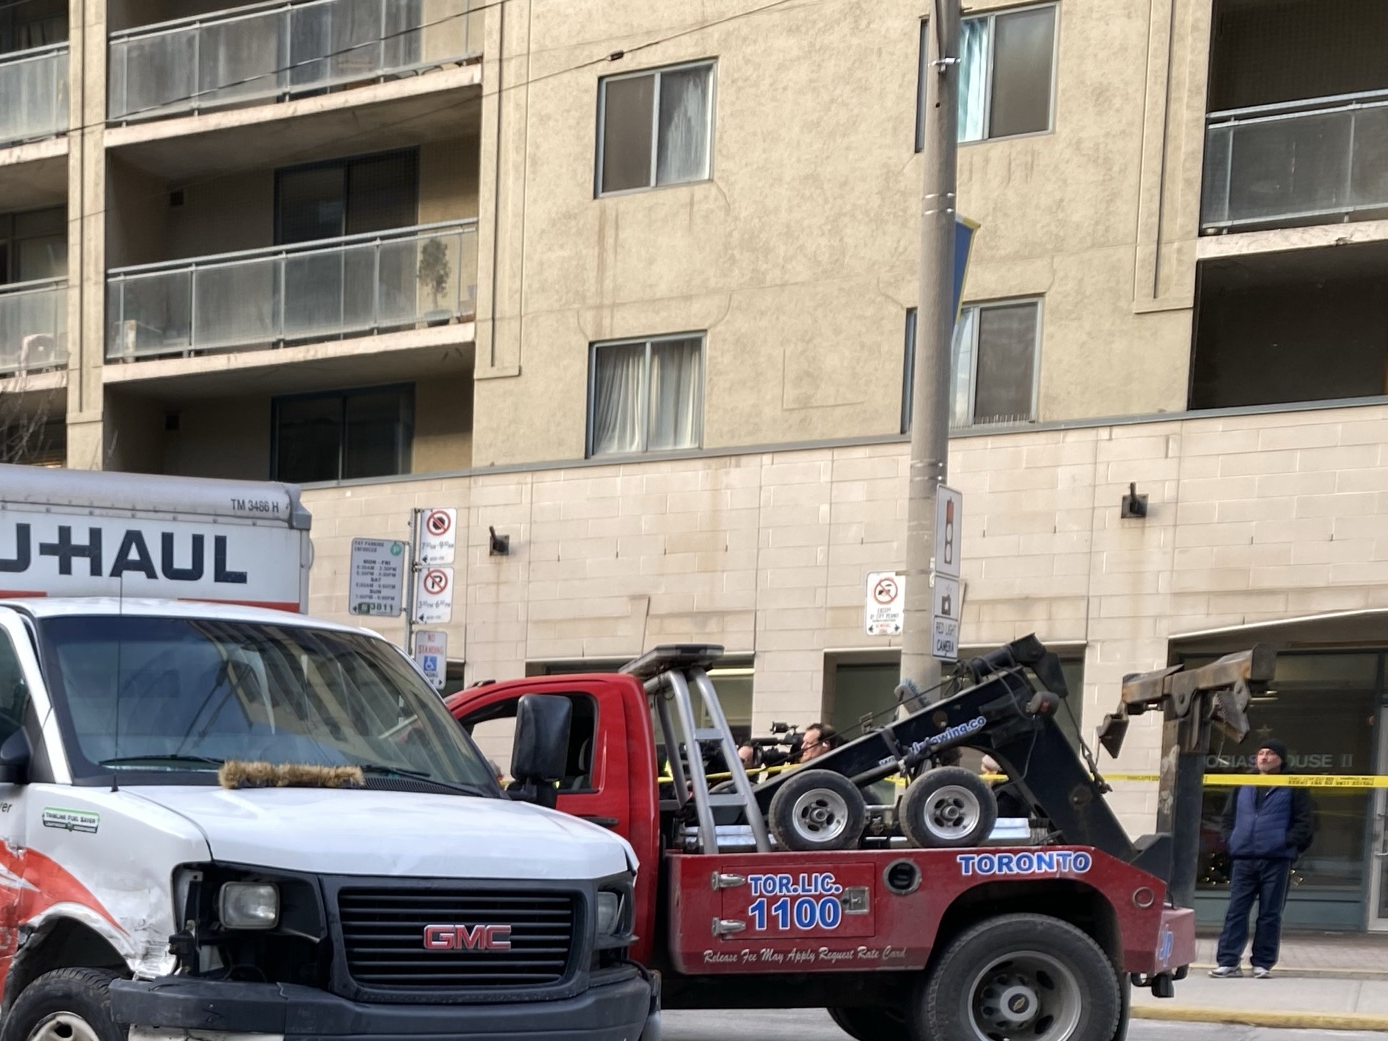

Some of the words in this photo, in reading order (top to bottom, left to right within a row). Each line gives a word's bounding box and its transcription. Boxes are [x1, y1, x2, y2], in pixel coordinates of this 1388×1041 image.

[230, 498, 246, 511] TM
[272, 501, 279, 513] H
[935, 621, 945, 635] RED
[945, 624, 957, 637] LIGHT
[936, 638, 955, 653] CAMERA
[1206, 753, 1257, 769] OBIAS
[1287, 754, 1333, 769] OUSE
[956, 850, 1094, 878] TORONTO
[747, 872, 843, 896] TOR.LIC.
[748, 896, 842, 930] 1100
[423, 924, 512, 951] GMC
[703, 949, 738, 964] Release
[740, 948, 757, 964] Fee
[760, 948, 784, 964] May
[786, 947, 815, 964] Apply
[818, 946, 854, 964] Request
[857, 945, 880, 960] Rate
[881, 945, 907, 961] Card
